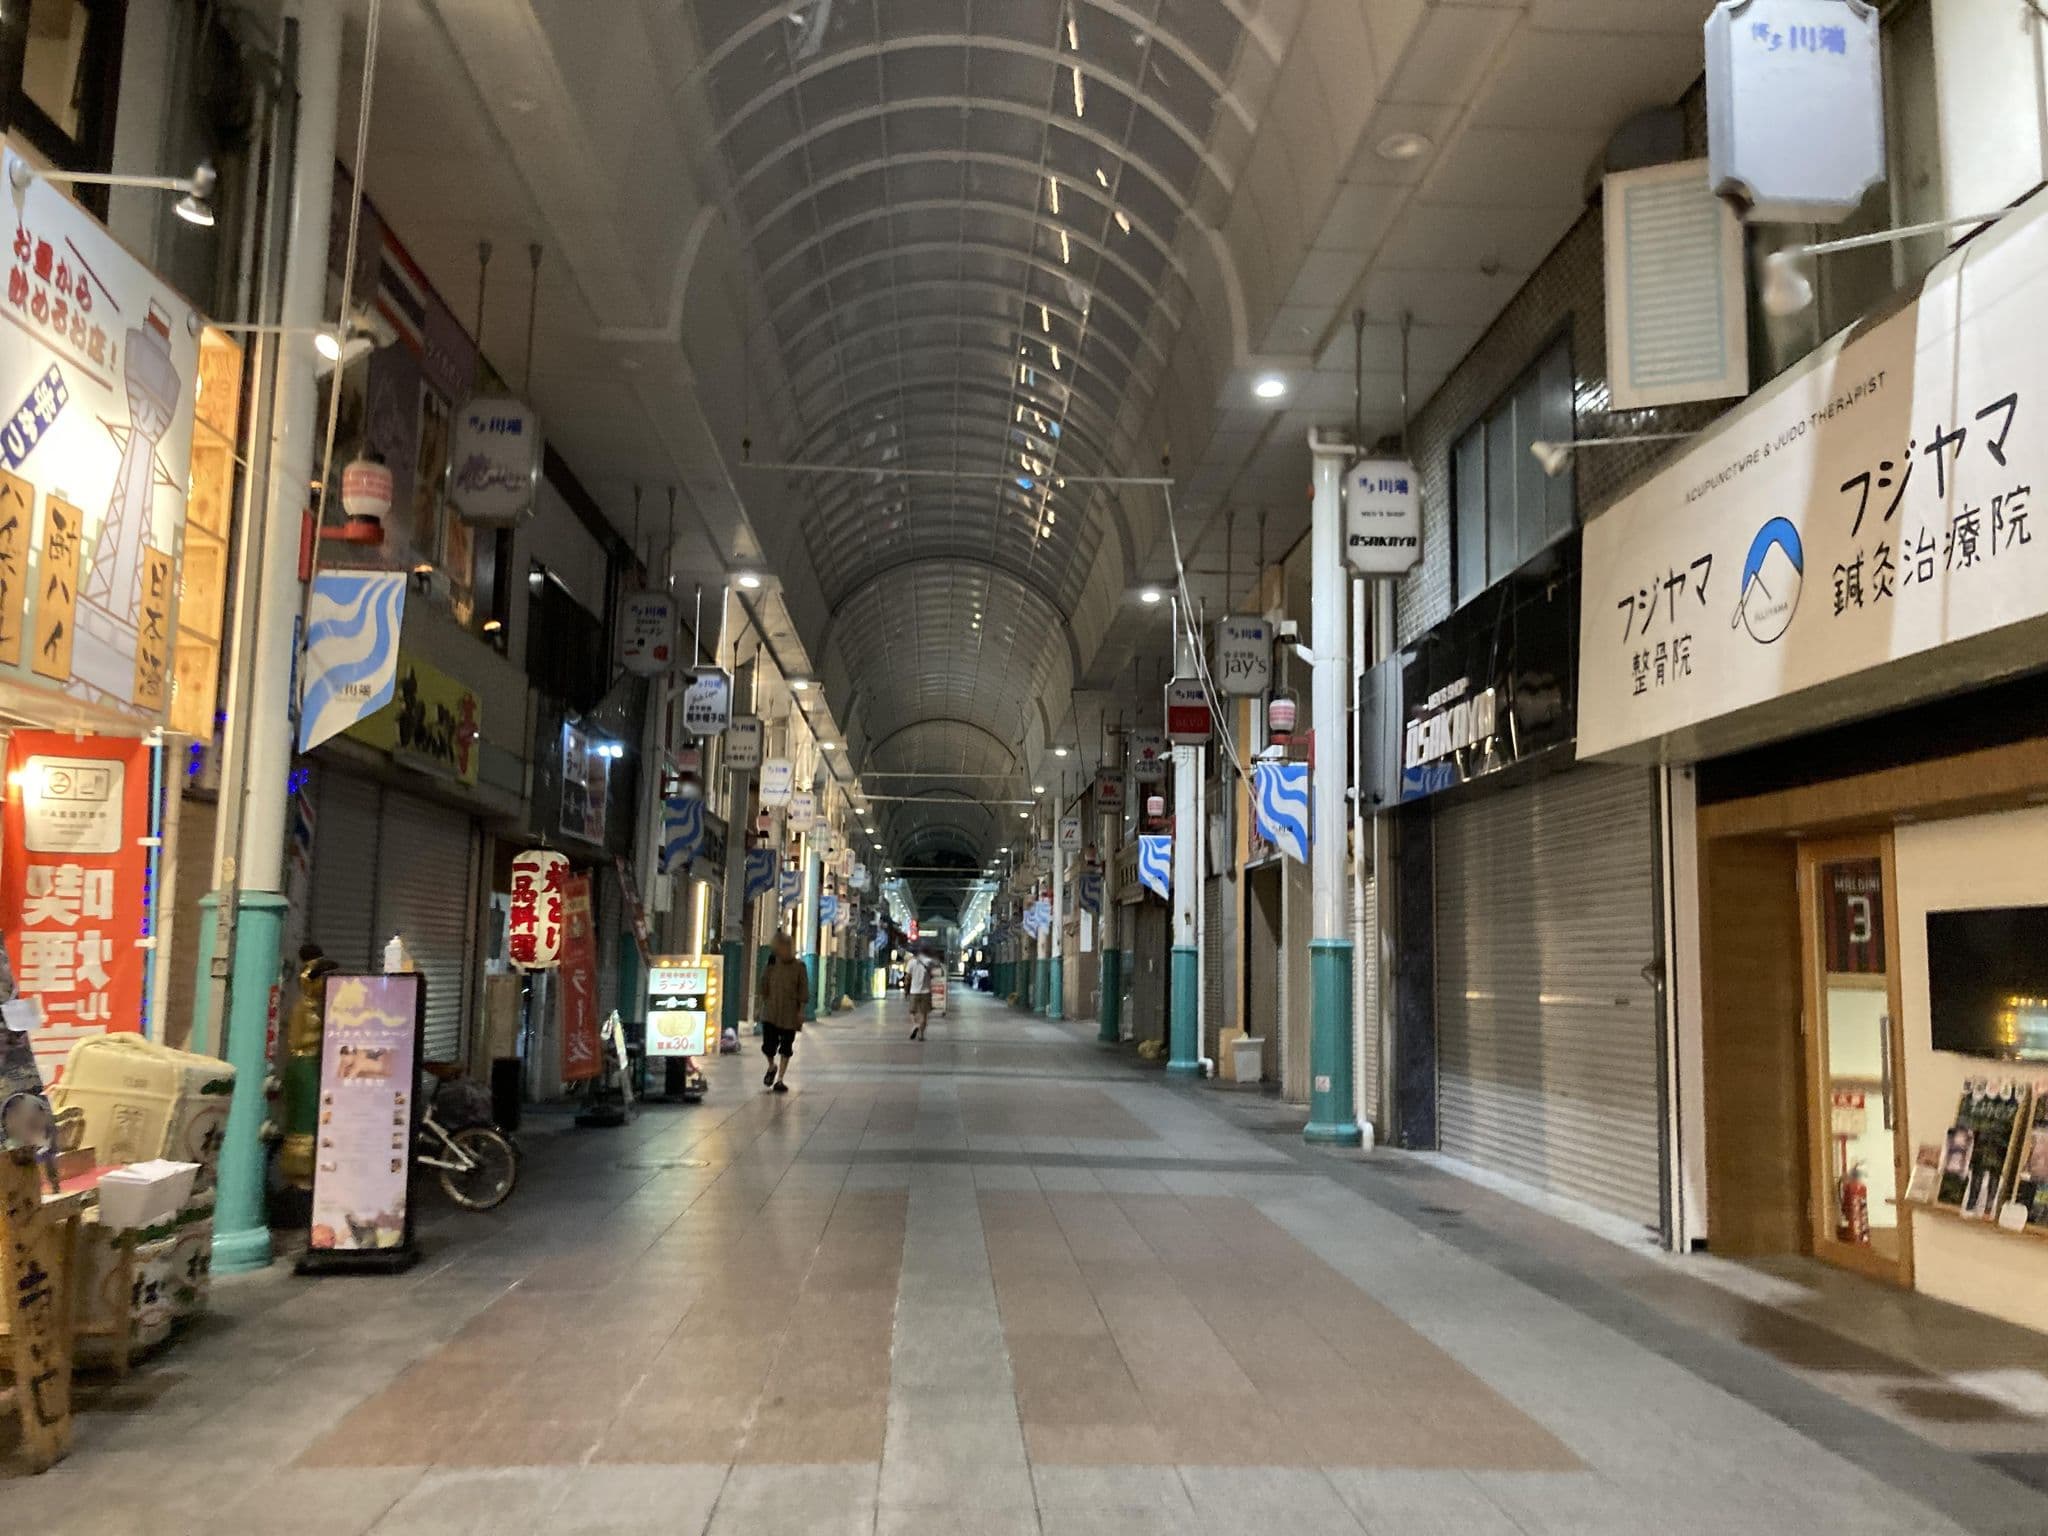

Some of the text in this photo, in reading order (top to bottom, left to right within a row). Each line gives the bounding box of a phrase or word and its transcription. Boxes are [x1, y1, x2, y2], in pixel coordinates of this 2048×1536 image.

[1774, 420, 1806, 452] JUDO
[1809, 371, 1887, 428] THERAPIST
[1841, 392, 2018, 538] フジヤマ
[1832, 485, 2032, 617] 鍼灸治療院
[1618, 553, 1713, 645] フジヤマ
[1225, 656, 1267, 679] jay's
[1632, 633, 1693, 696] 整骨院
[510, 862, 540, 962] 一品料理
[1847, 896, 1871, 943] 3
[659, 980, 697, 990] ラーメン
